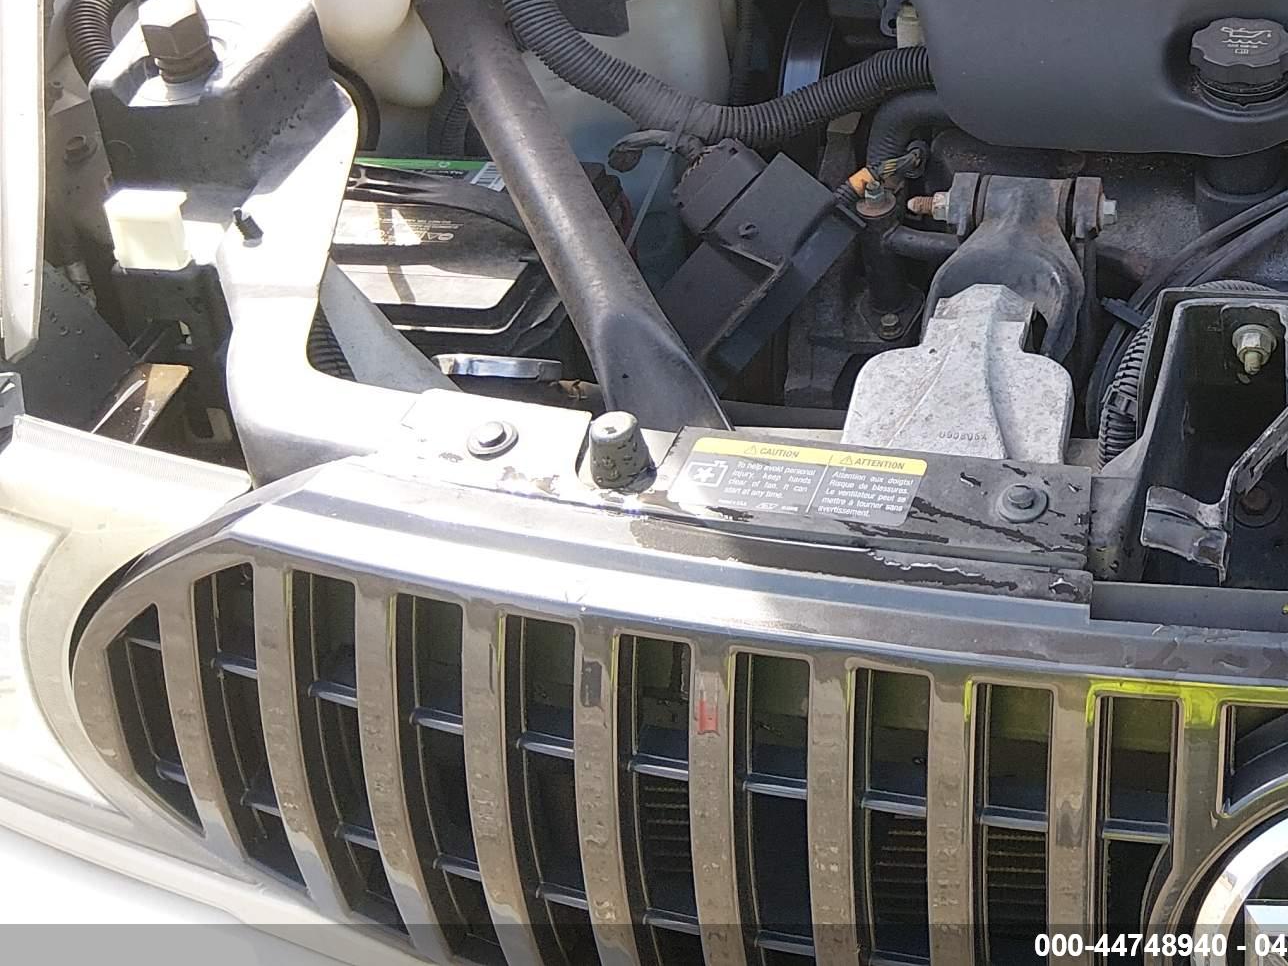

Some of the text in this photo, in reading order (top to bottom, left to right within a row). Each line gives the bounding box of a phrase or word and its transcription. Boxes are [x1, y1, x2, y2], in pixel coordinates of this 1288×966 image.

[759, 446, 800, 458] CAUTION
[746, 462, 763, 470] help
[764, 464, 784, 472] avoid
[784, 467, 816, 476] personal
[854, 458, 906, 470] ATTENTION
[762, 472, 782, 482] keep
[788, 476, 812, 484] hands
[832, 471, 867, 481] Attention
[752, 480, 759, 488] of
[829, 479, 855, 490] Risque
[858, 482, 868, 490] de
[750, 490, 764, 498] any
[765, 491, 784, 499] time.
[838, 490, 876, 500] ventilateur
[877, 494, 895, 503] peut
[817, 504, 872, 517] avertissement.
[822, 497, 847, 506] mettre
[856, 500, 884, 509] tourner
[885, 504, 904, 512] sans
